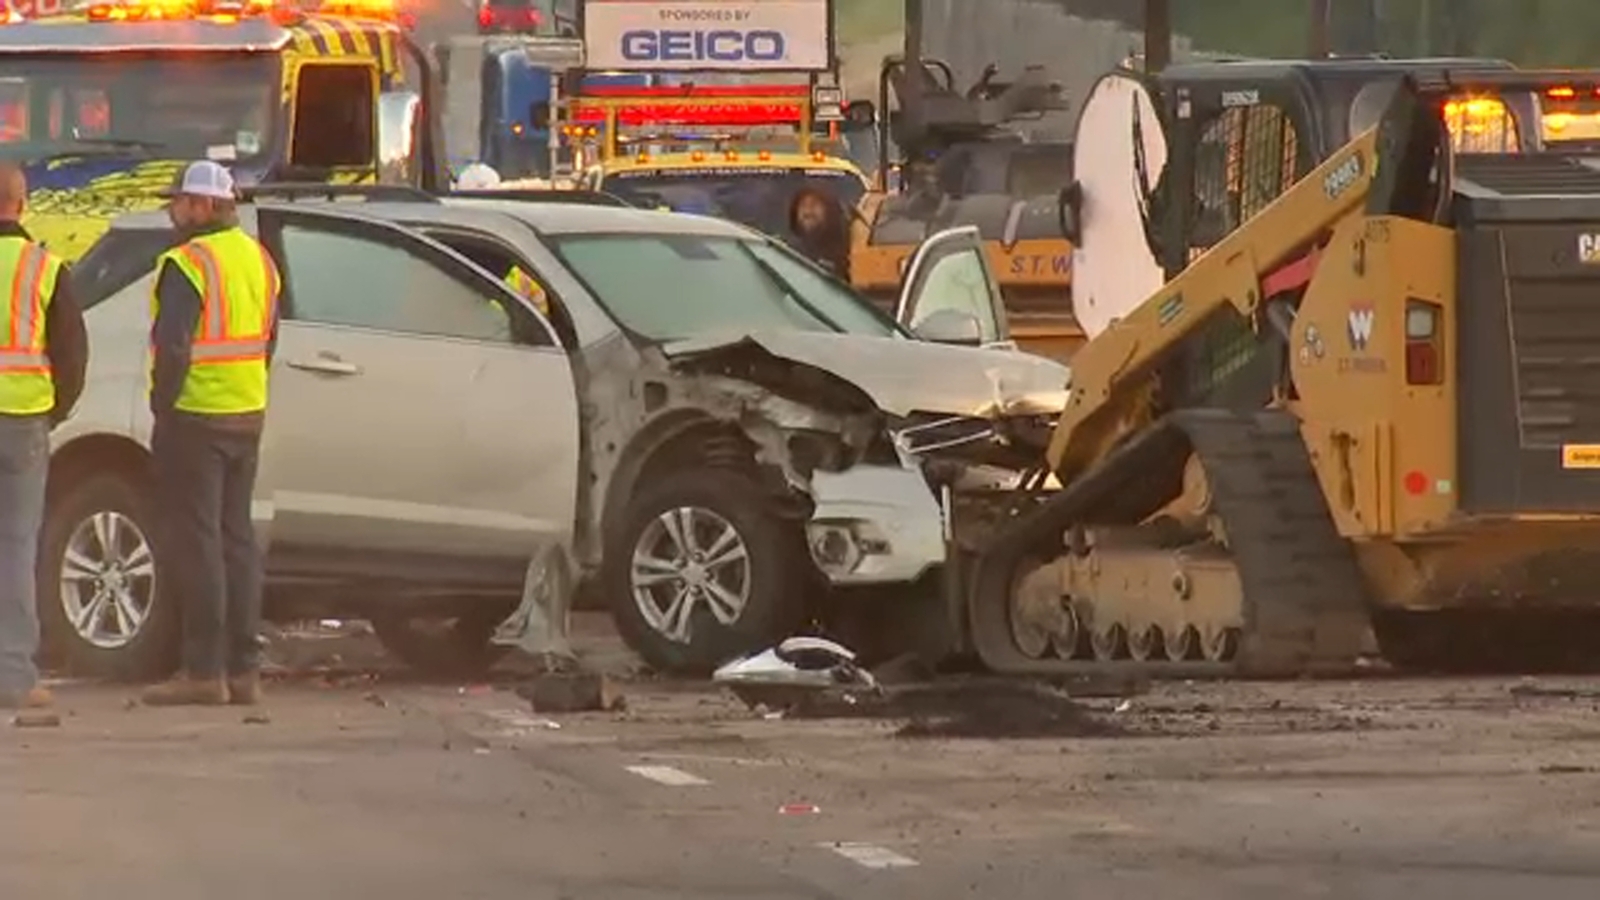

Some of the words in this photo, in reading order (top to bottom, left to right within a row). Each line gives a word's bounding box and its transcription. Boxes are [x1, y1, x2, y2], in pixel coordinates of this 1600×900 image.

[659, 9, 733, 21] SPONSORED
[734, 10, 751, 21] BY
[621, 30, 786, 61] GEICO
